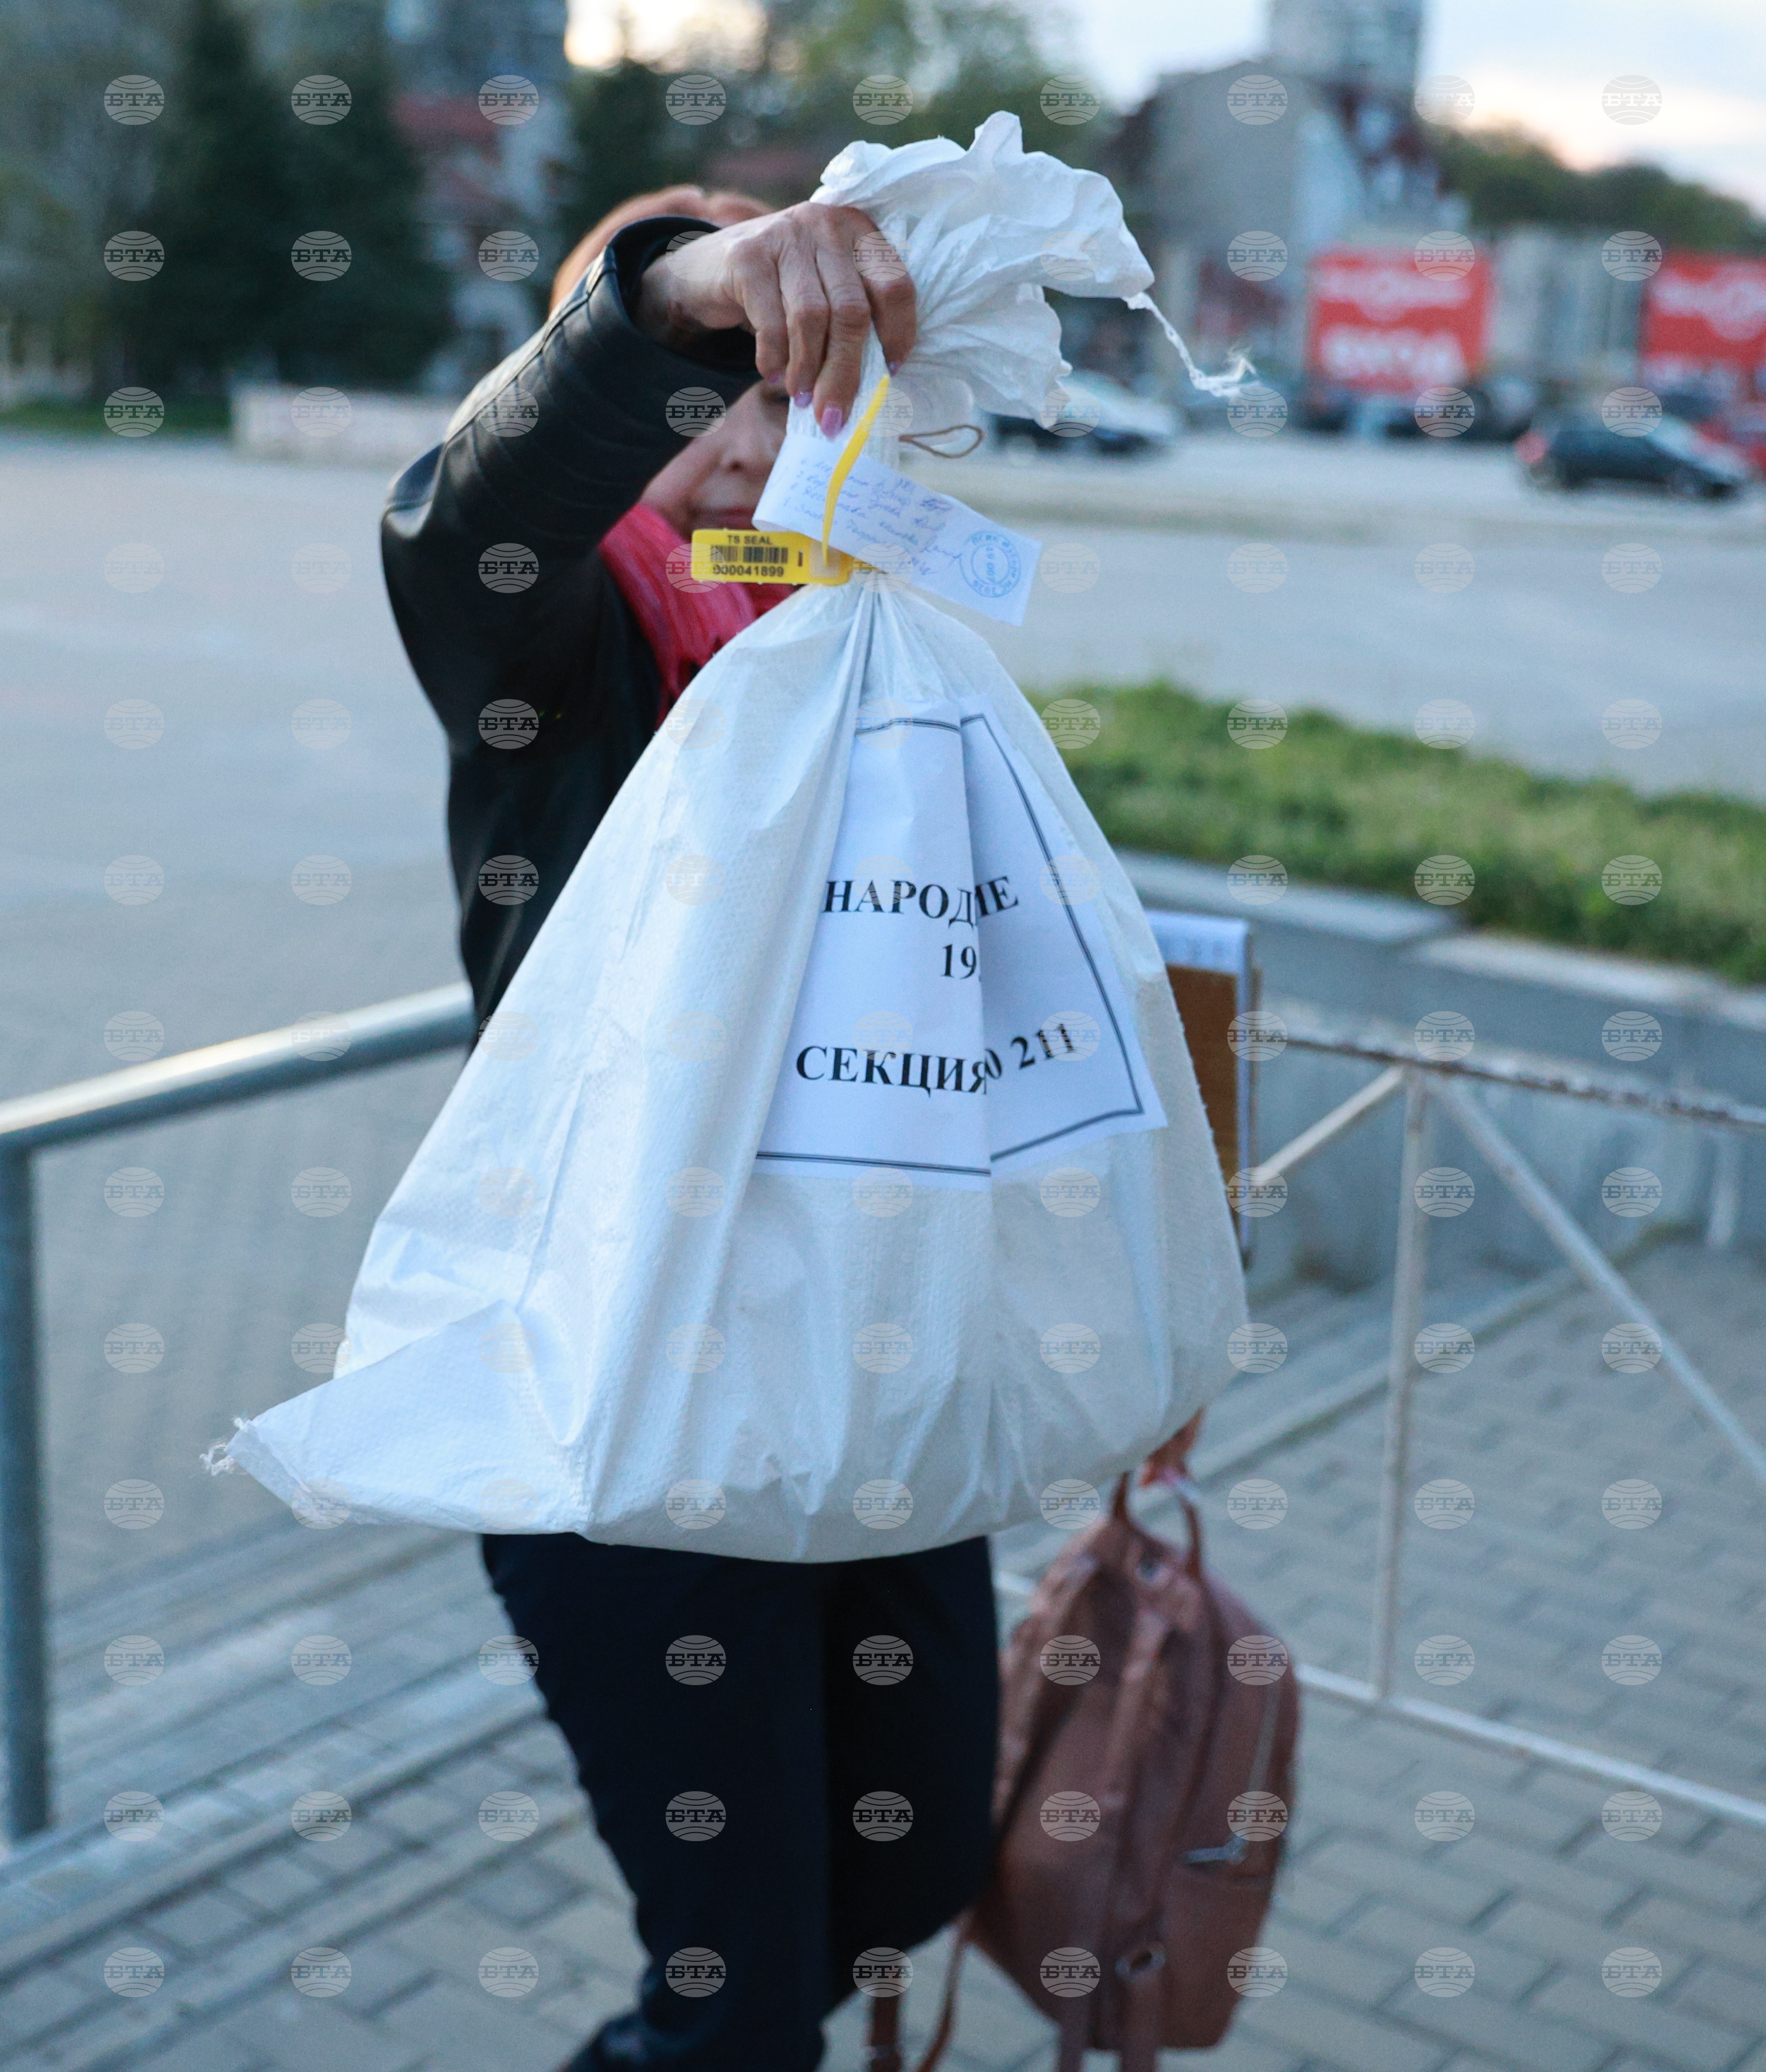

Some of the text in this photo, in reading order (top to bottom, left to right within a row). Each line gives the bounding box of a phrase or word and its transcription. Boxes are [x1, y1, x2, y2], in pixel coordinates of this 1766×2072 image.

[728, 535, 772, 545] TS SEAL
[796, 1045, 987, 1097] СЕКЦИЯ
